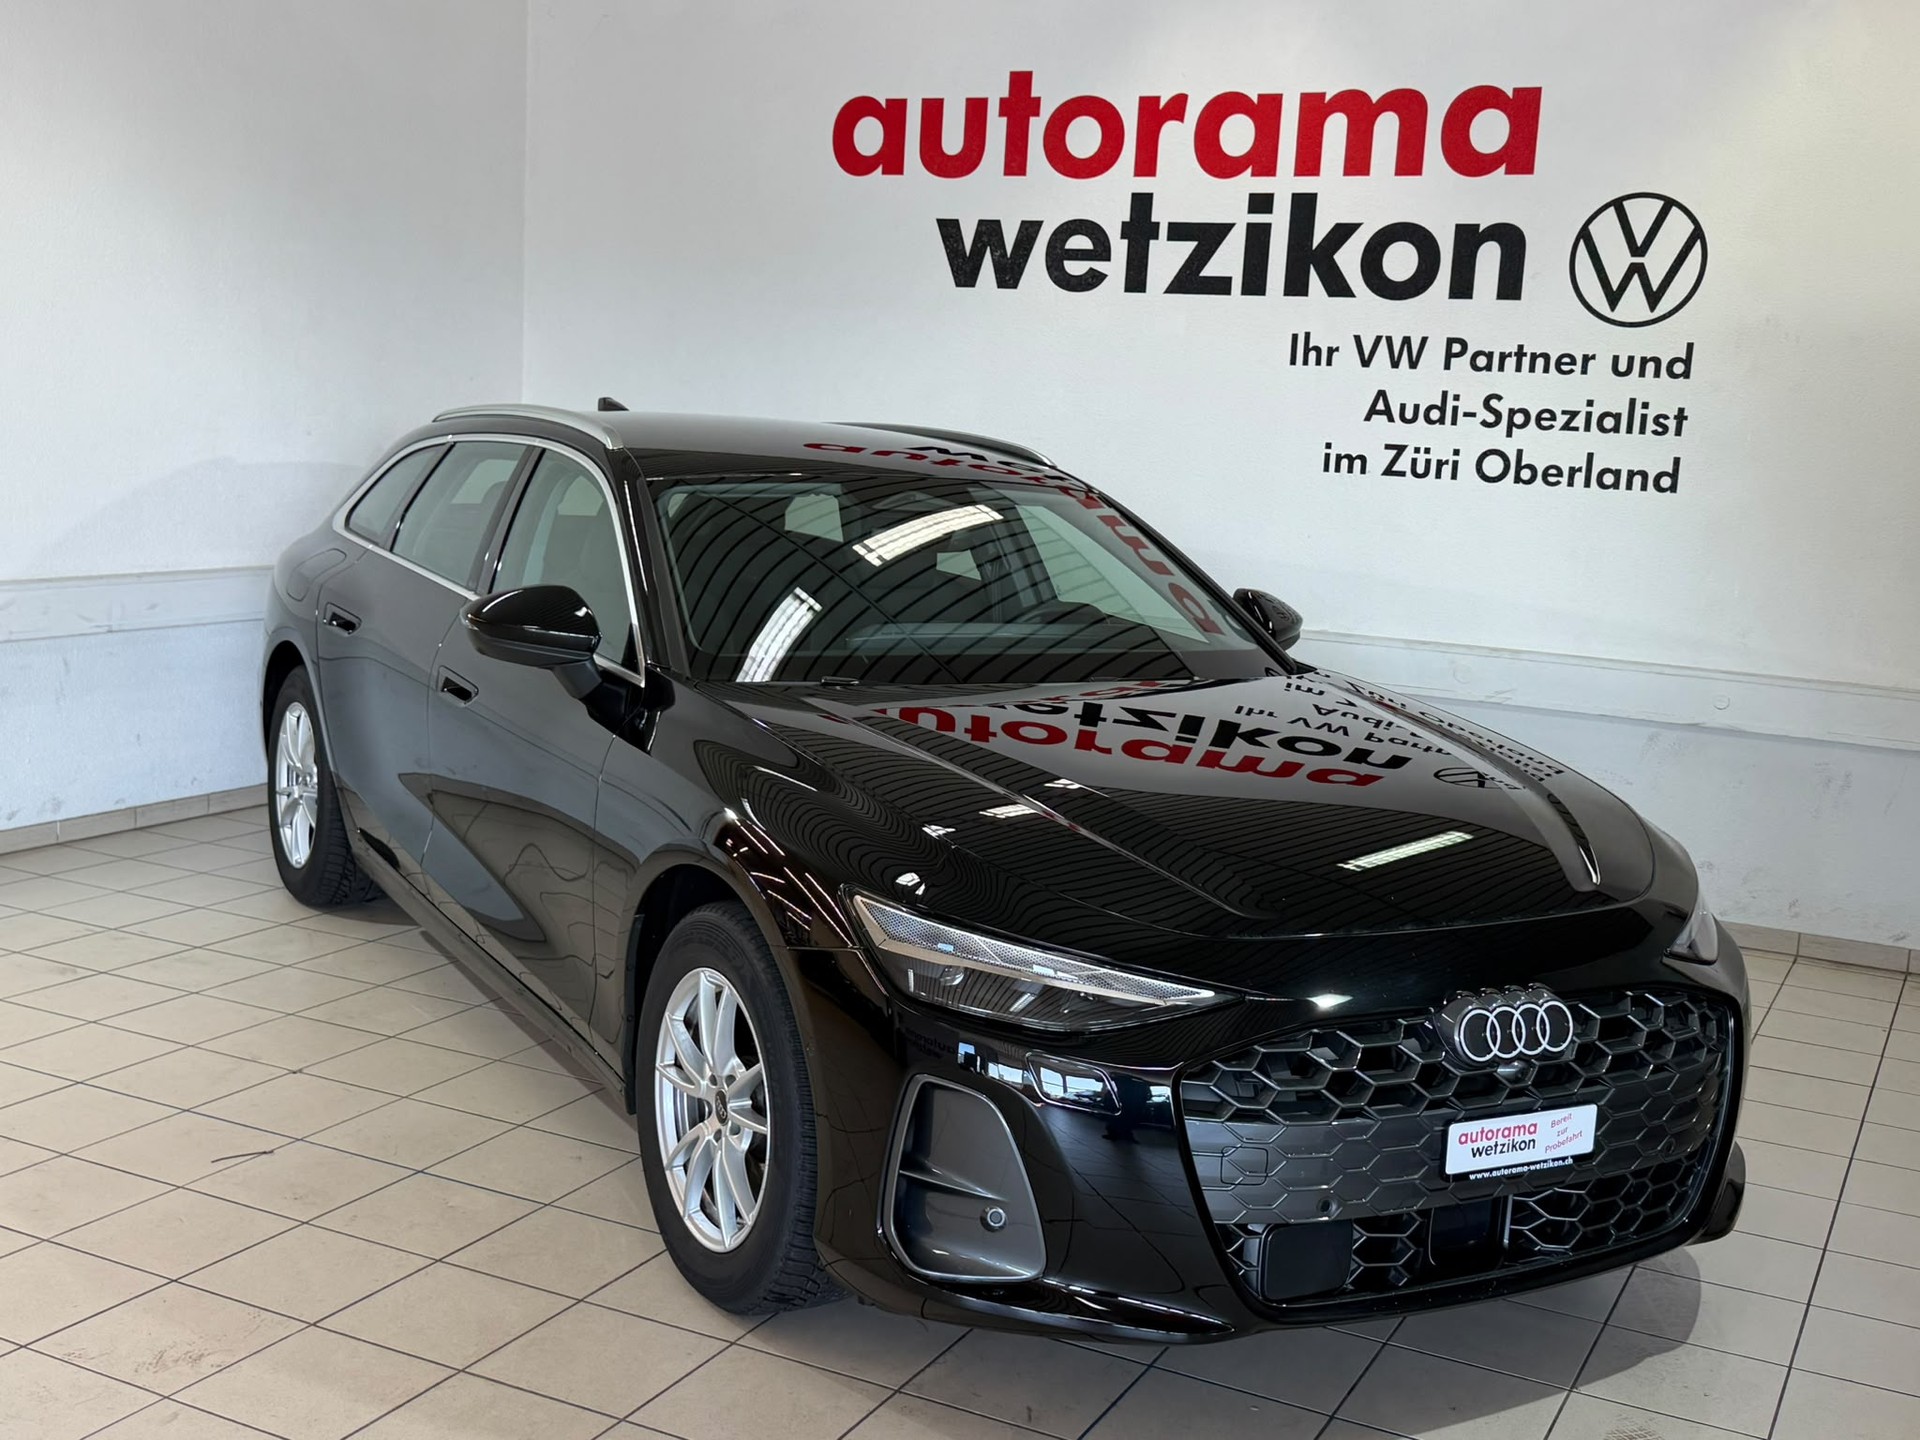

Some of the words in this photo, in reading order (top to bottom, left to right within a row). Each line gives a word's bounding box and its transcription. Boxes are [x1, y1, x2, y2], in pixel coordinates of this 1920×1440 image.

[833, 72, 1541, 179] autorama
[936, 193, 1526, 300] wetzikon
[1290, 332, 1340, 367] Ihr
[1354, 335, 1428, 370] VW
[1444, 337, 1597, 378] Partner
[1611, 343, 1694, 380] und
[1364, 390, 1688, 437] Audi-Spezialist
[1324, 443, 1368, 475] im
[1381, 444, 1460, 481] Züri
[1476, 449, 1681, 493] Oberland
[1550, 1112, 1573, 1129] Bereit
[1556, 1127, 1568, 1137] zur
[1458, 1122, 1538, 1146] autorama
[1544, 1130, 1583, 1154] Probefahrt
[1471, 1137, 1536, 1158] wetzikon
[1469, 1156, 1574, 1180] www.autorama-wetzikon.ch
